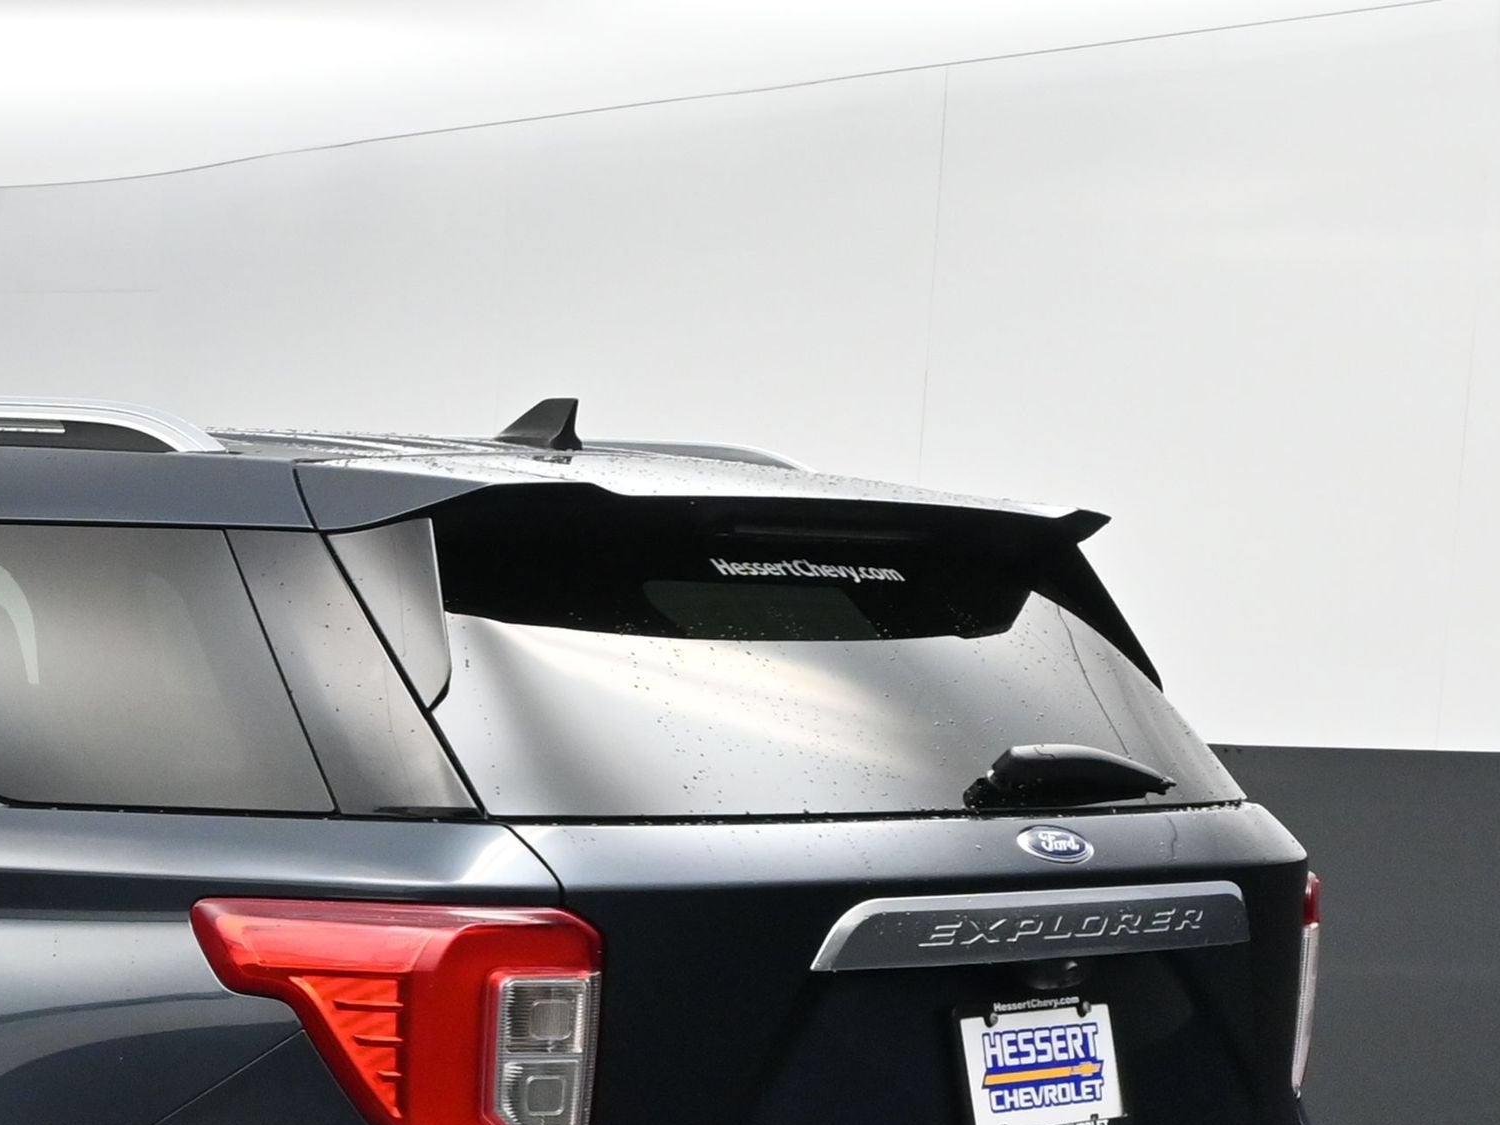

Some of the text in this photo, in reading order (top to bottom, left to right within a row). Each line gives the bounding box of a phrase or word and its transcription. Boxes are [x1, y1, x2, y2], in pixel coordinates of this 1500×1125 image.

[709, 558, 906, 583] HessertChevy.com
[1037, 832, 1080, 852] Ford
[918, 907, 1204, 948] EXPLORER
[993, 996, 1080, 1013] HessertChevy.com
[982, 1023, 1099, 1070] HESSERT
[989, 1079, 1104, 1113] CHEVROLET
